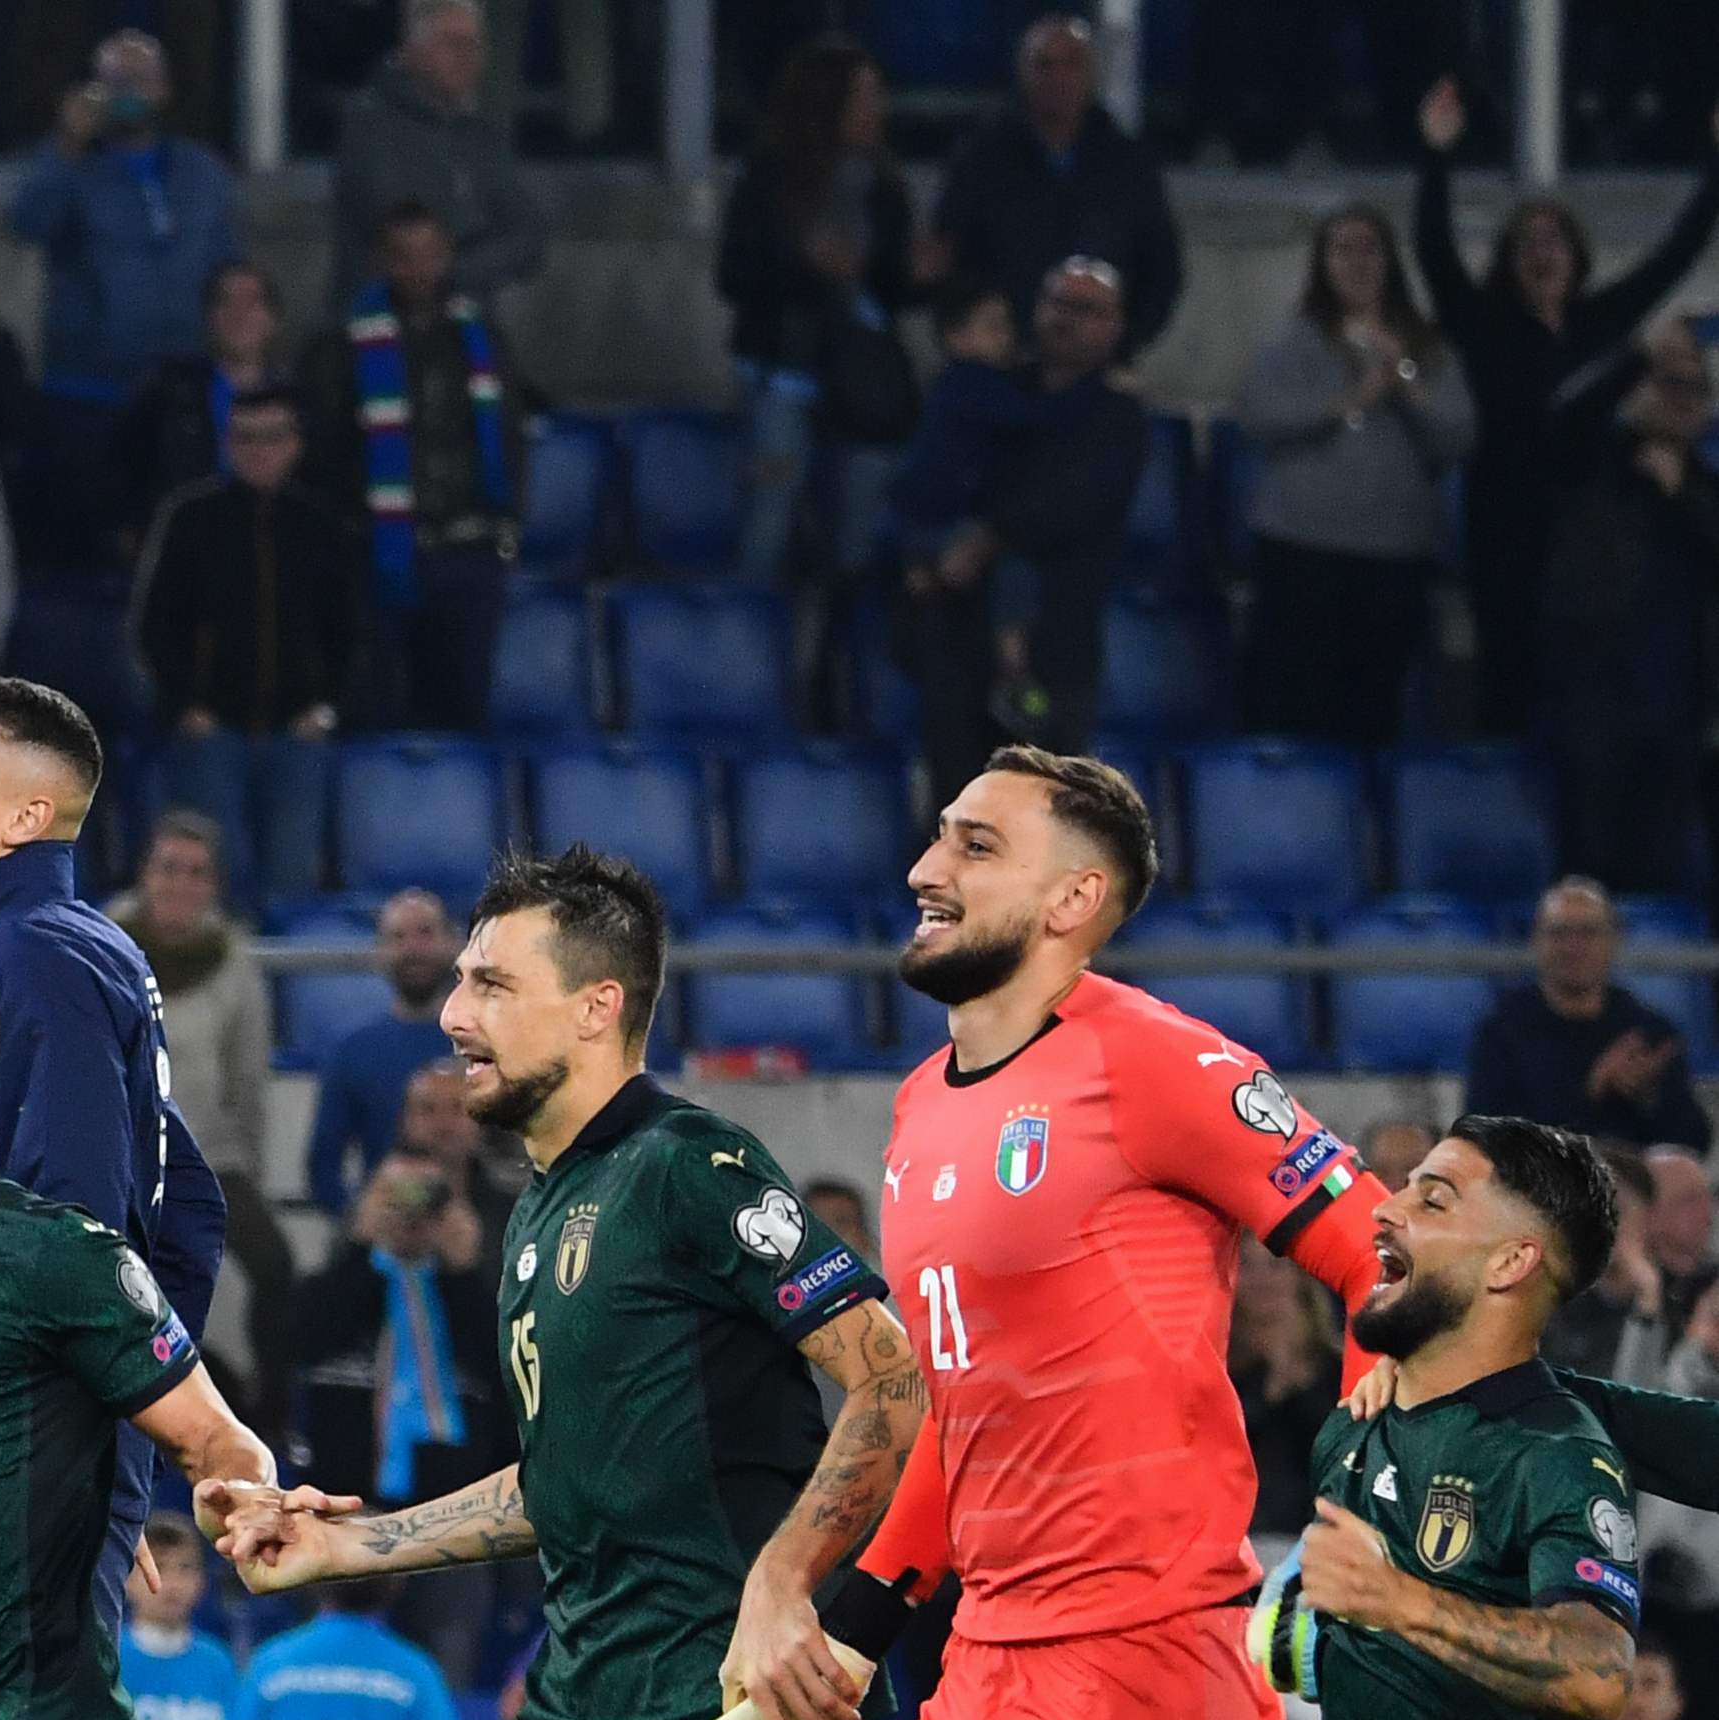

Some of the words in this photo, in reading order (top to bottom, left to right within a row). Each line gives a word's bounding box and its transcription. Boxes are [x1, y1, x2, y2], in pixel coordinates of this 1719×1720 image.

[799, 1252, 853, 1294] RESPECT
[918, 1263, 972, 1371] 21
[1431, 1494, 1470, 1512] ITALIA
